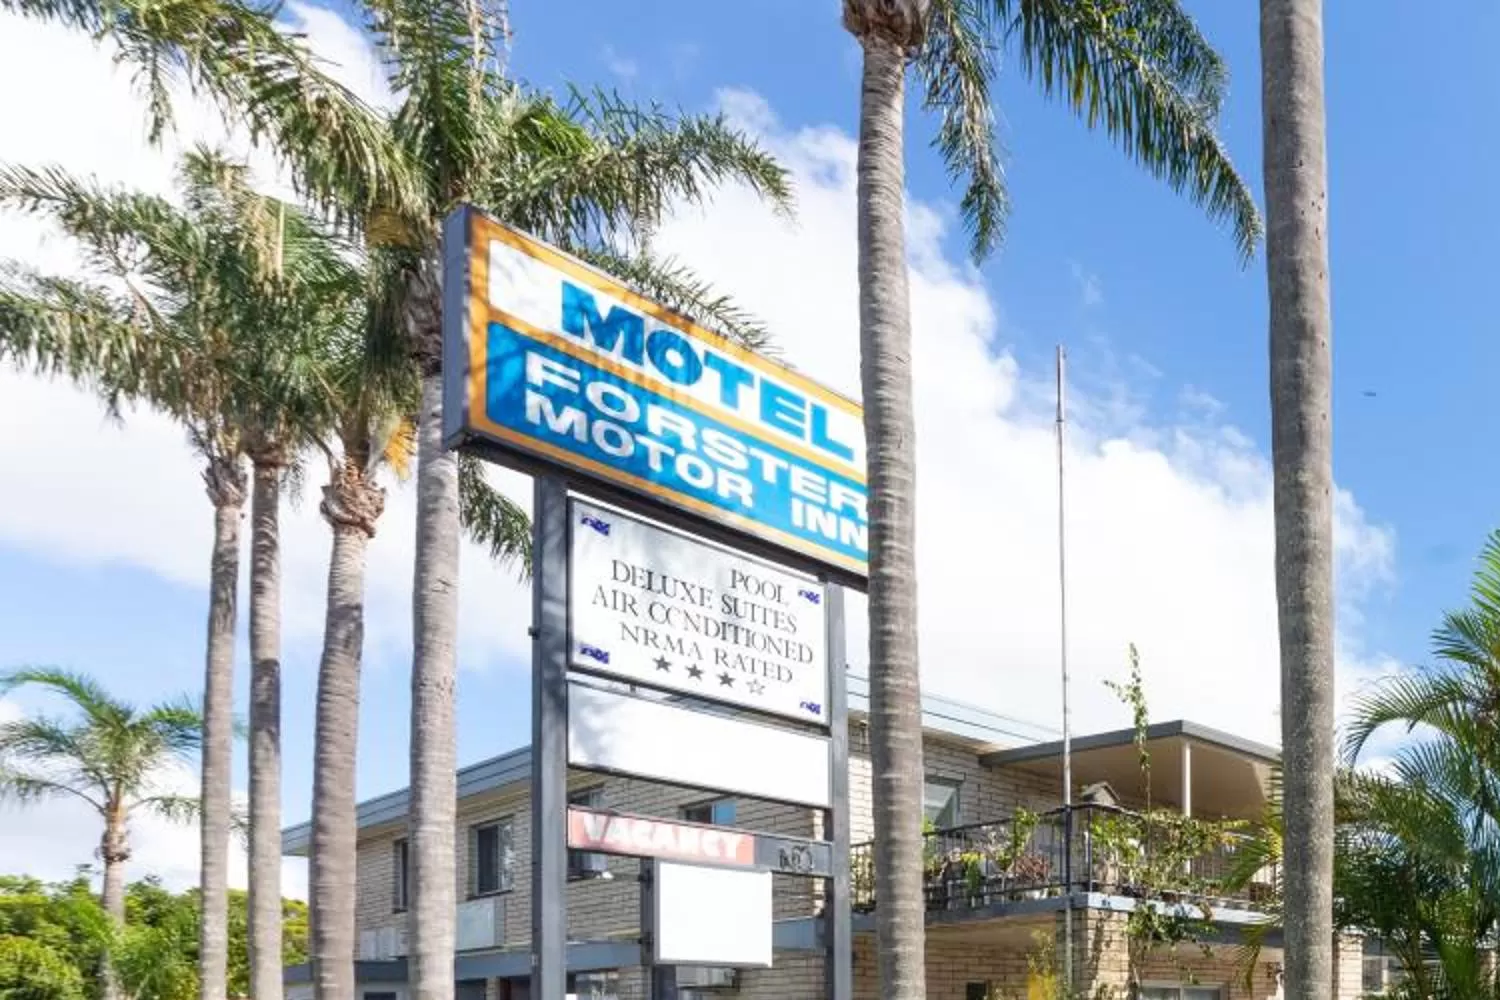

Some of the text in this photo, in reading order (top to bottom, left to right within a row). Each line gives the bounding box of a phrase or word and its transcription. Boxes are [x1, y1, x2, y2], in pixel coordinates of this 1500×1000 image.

[562, 280, 857, 462] MOTEL
[525, 350, 868, 522] FORSTER
[525, 389, 868, 551] MOTOR INN
[592, 585, 814, 664] AIR CONDITIONED
[611, 559, 798, 634] DELUXE SUITES
[730, 569, 787, 605] POOL
[619, 622, 793, 684] NRMA RATED
[583, 813, 744, 858] VACANCY
